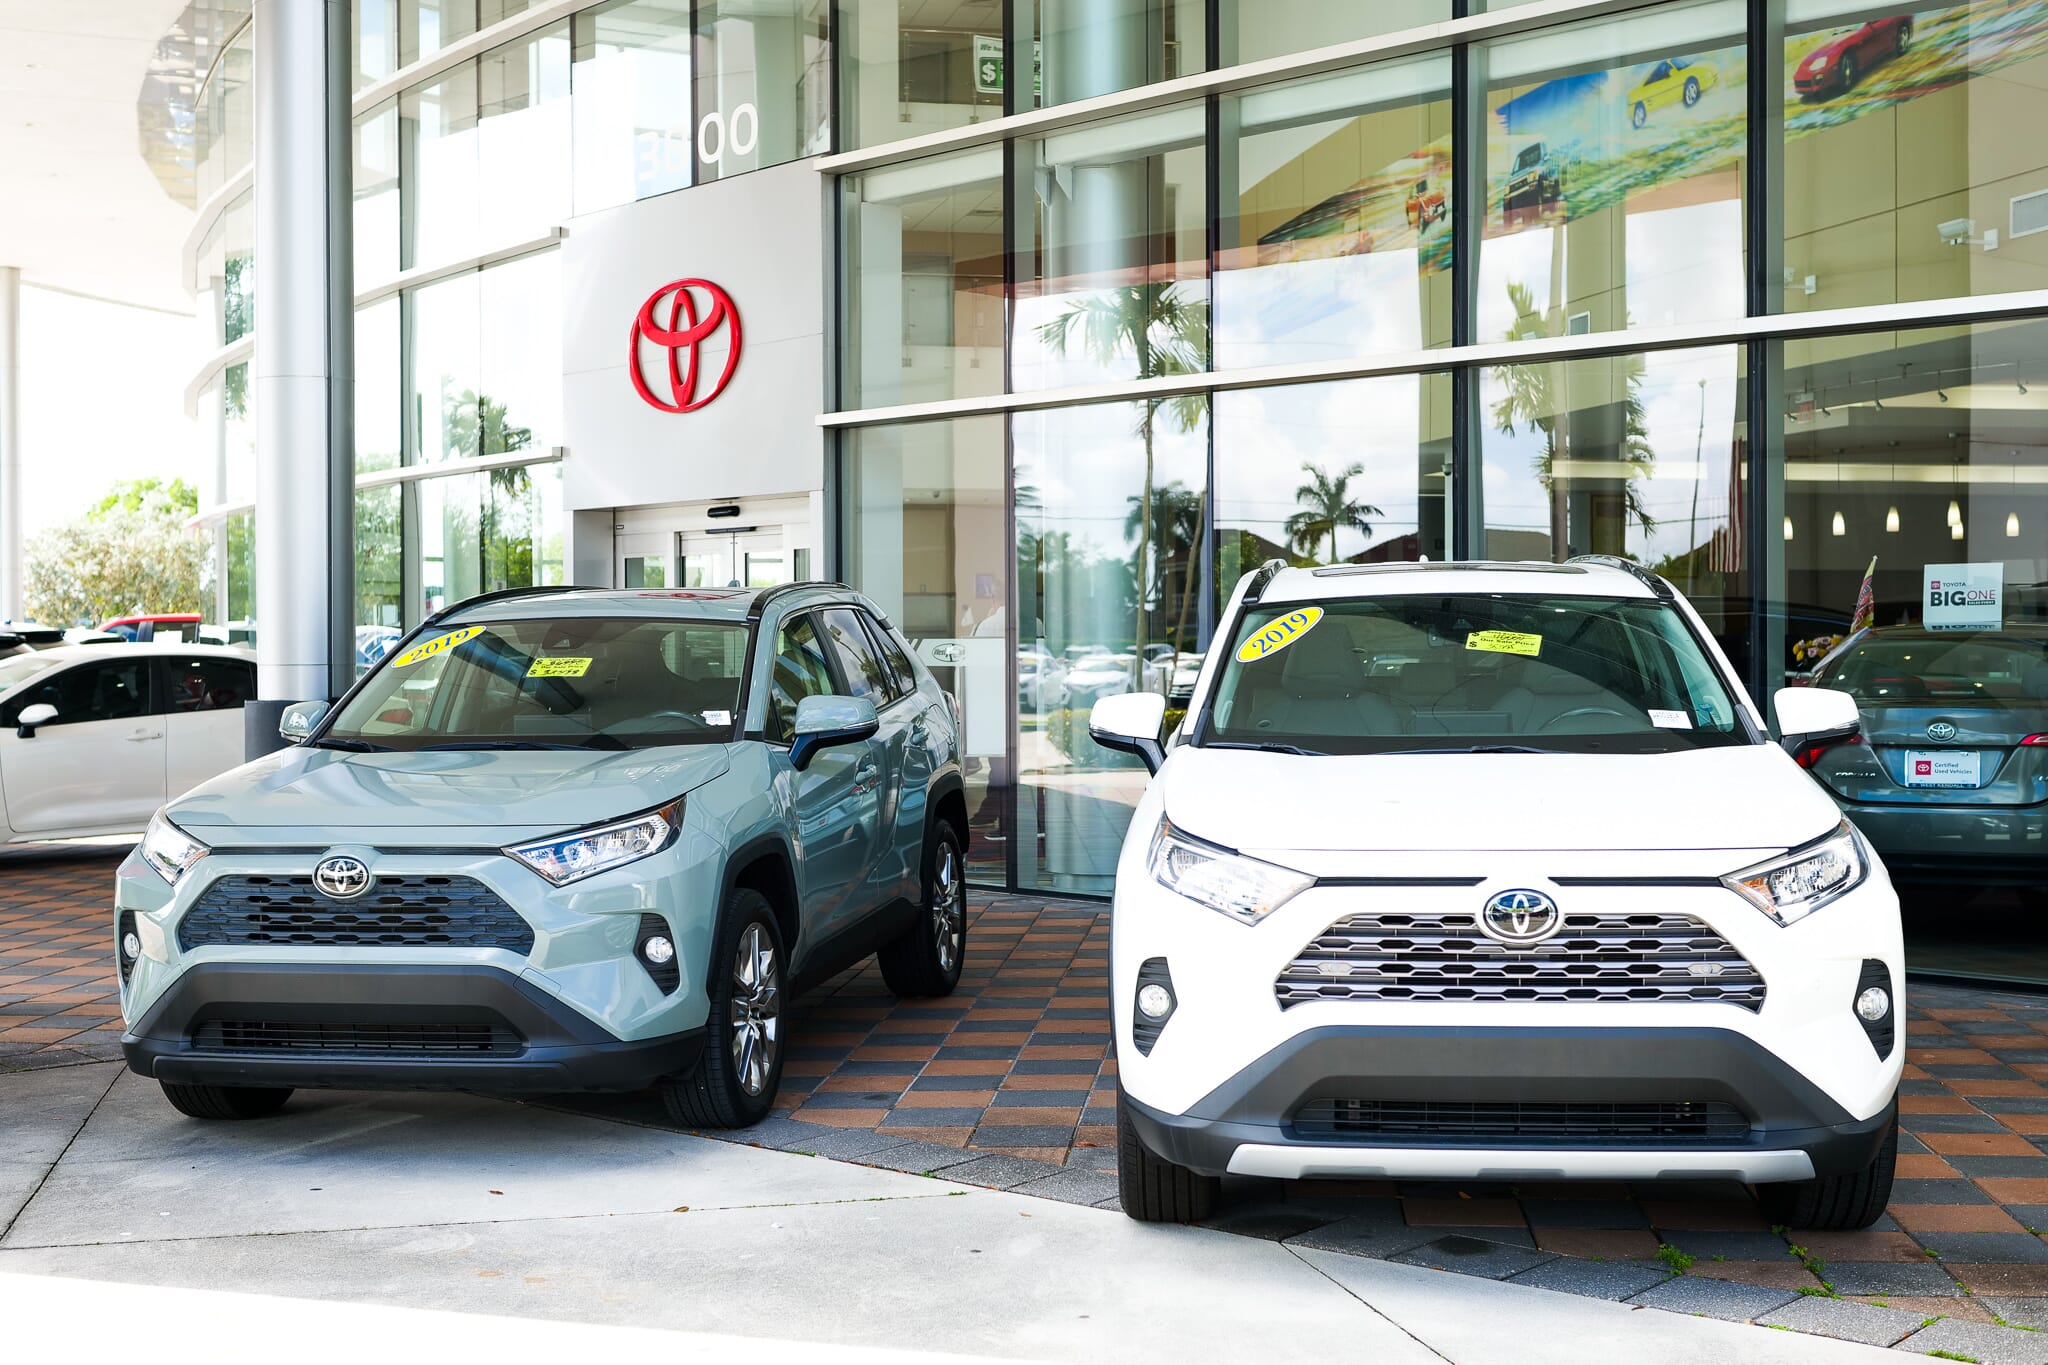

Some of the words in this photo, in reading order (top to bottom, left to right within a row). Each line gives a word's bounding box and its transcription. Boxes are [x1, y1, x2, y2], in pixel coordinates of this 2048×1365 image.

[1930, 590, 1966, 606] BIG
[1967, 590, 1996, 600] ONE
[410, 630, 470, 661] 2019
[1252, 613, 1308, 653] 2019
